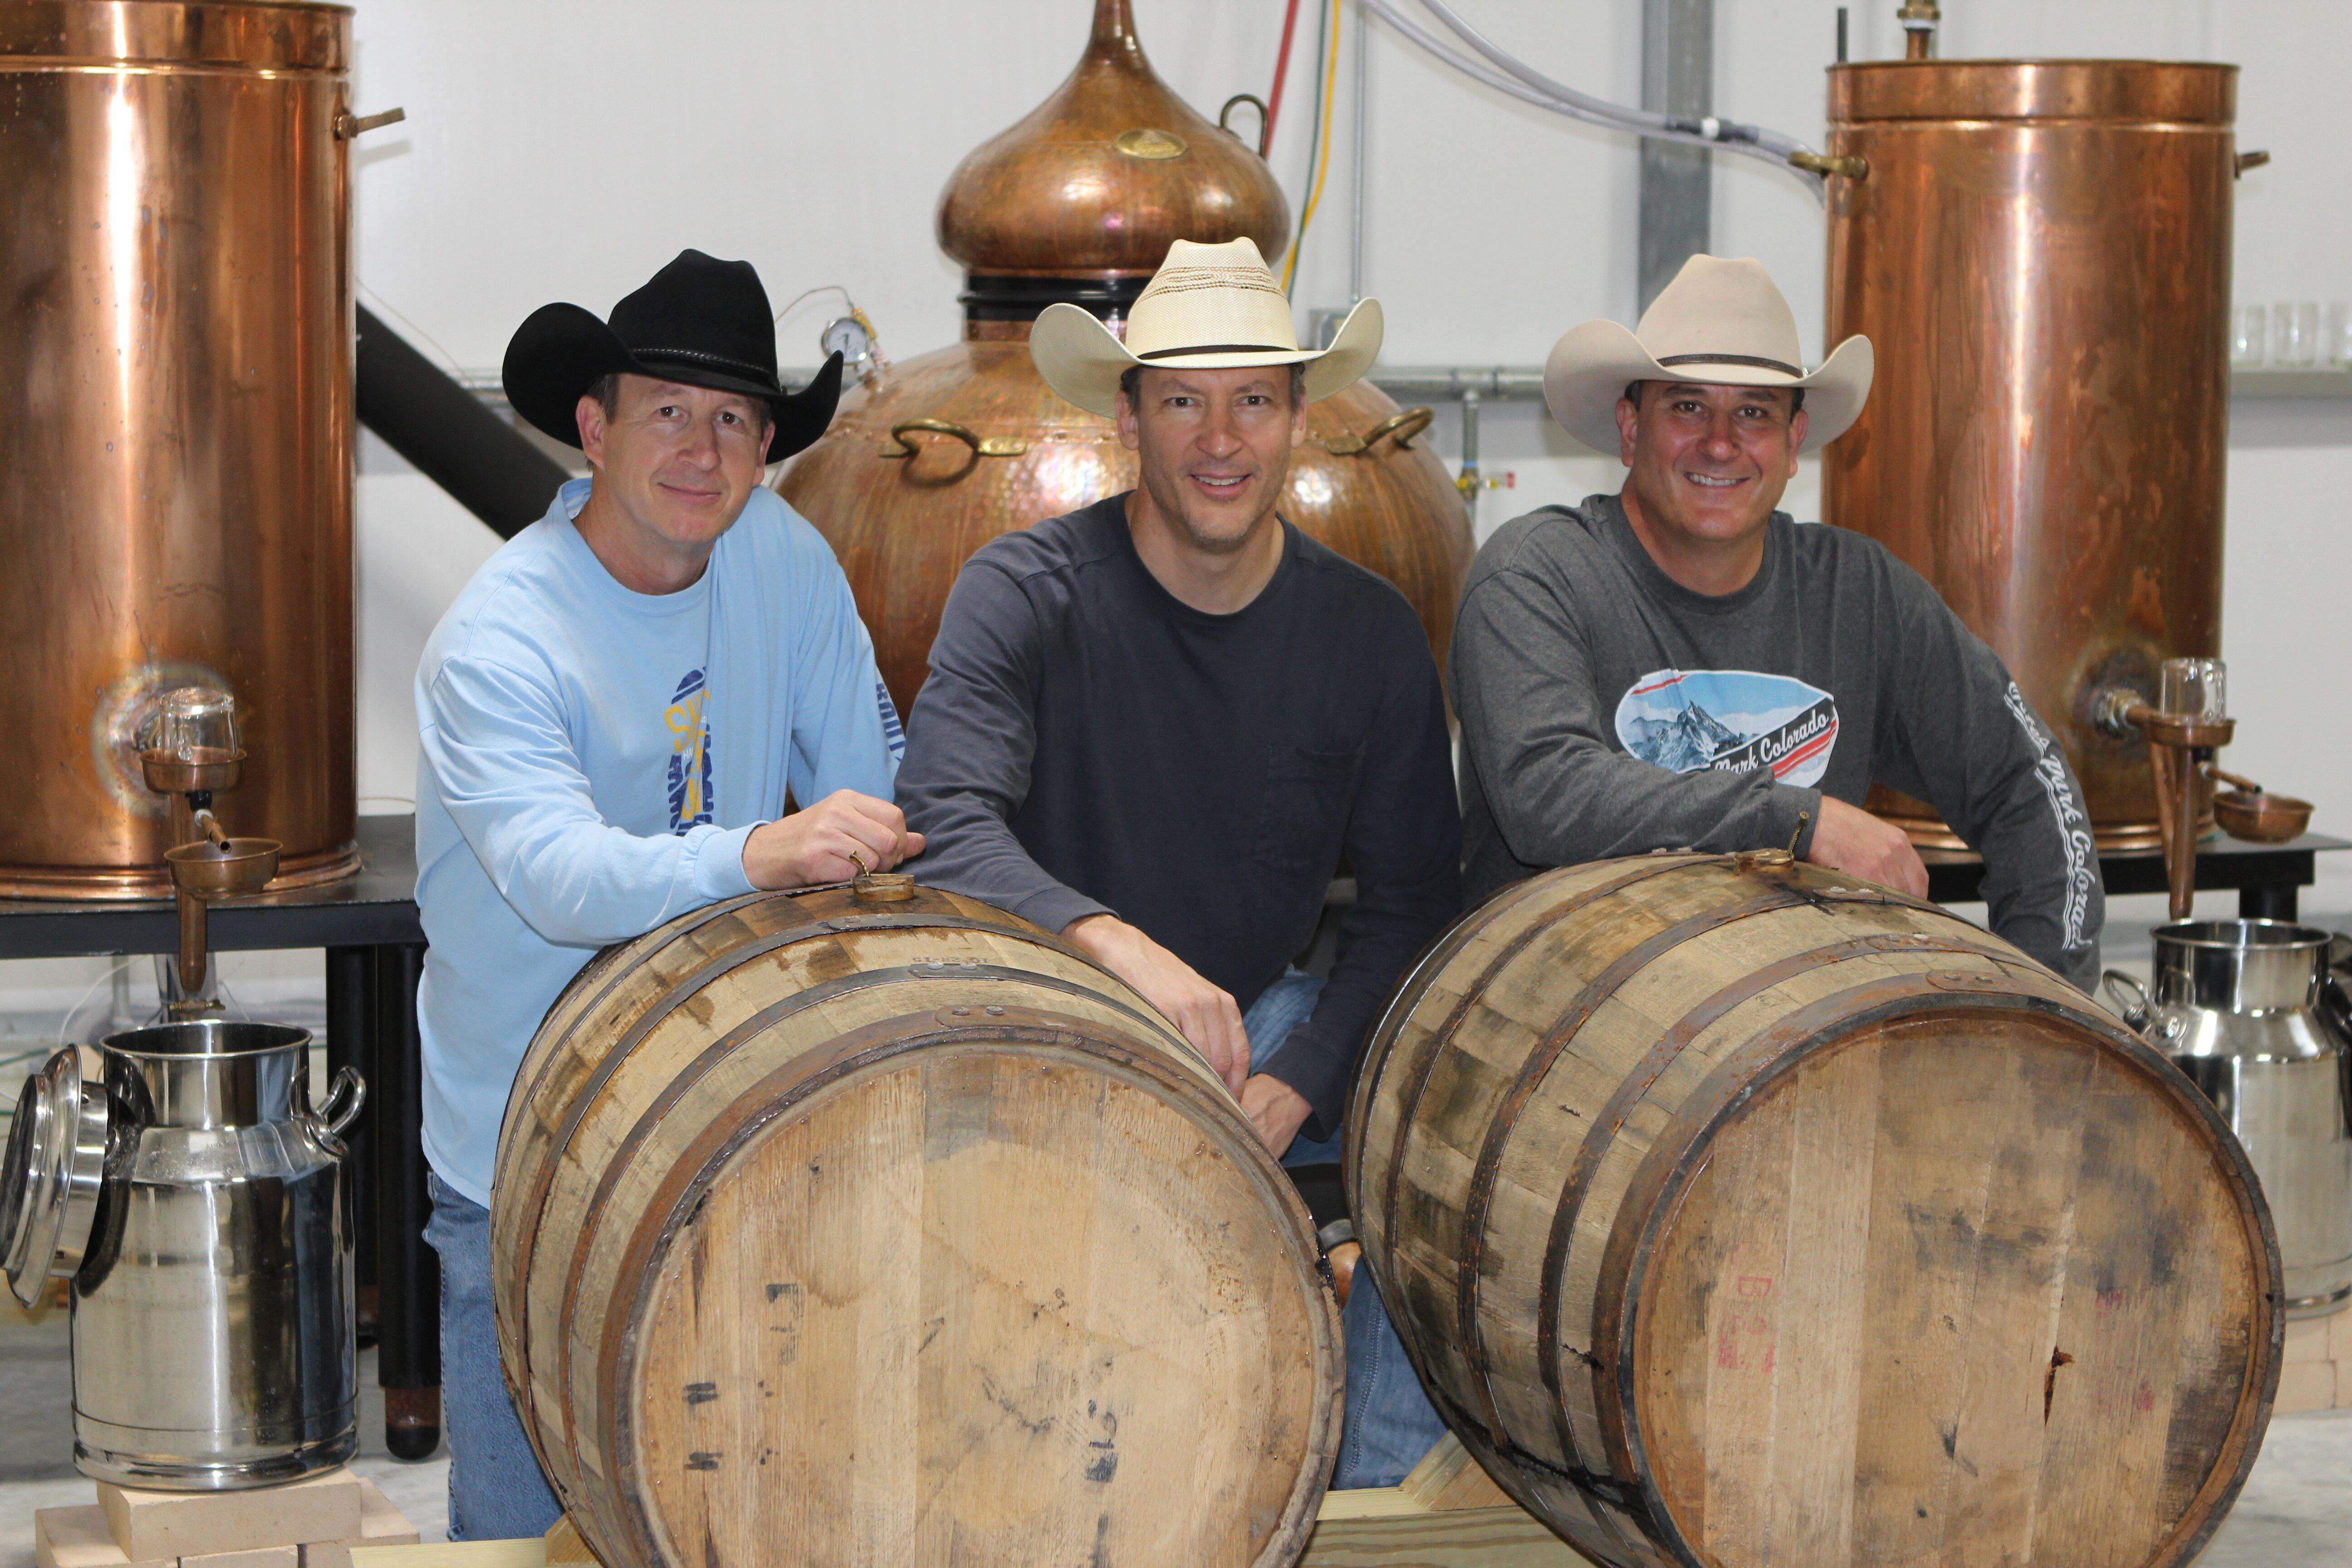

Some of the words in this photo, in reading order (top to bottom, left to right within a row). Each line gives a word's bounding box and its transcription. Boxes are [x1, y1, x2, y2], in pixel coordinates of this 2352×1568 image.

[1760, 709, 1829, 763] Colorado
[2040, 754, 2082, 824] Park
[2069, 829, 2096, 949] Colorad
